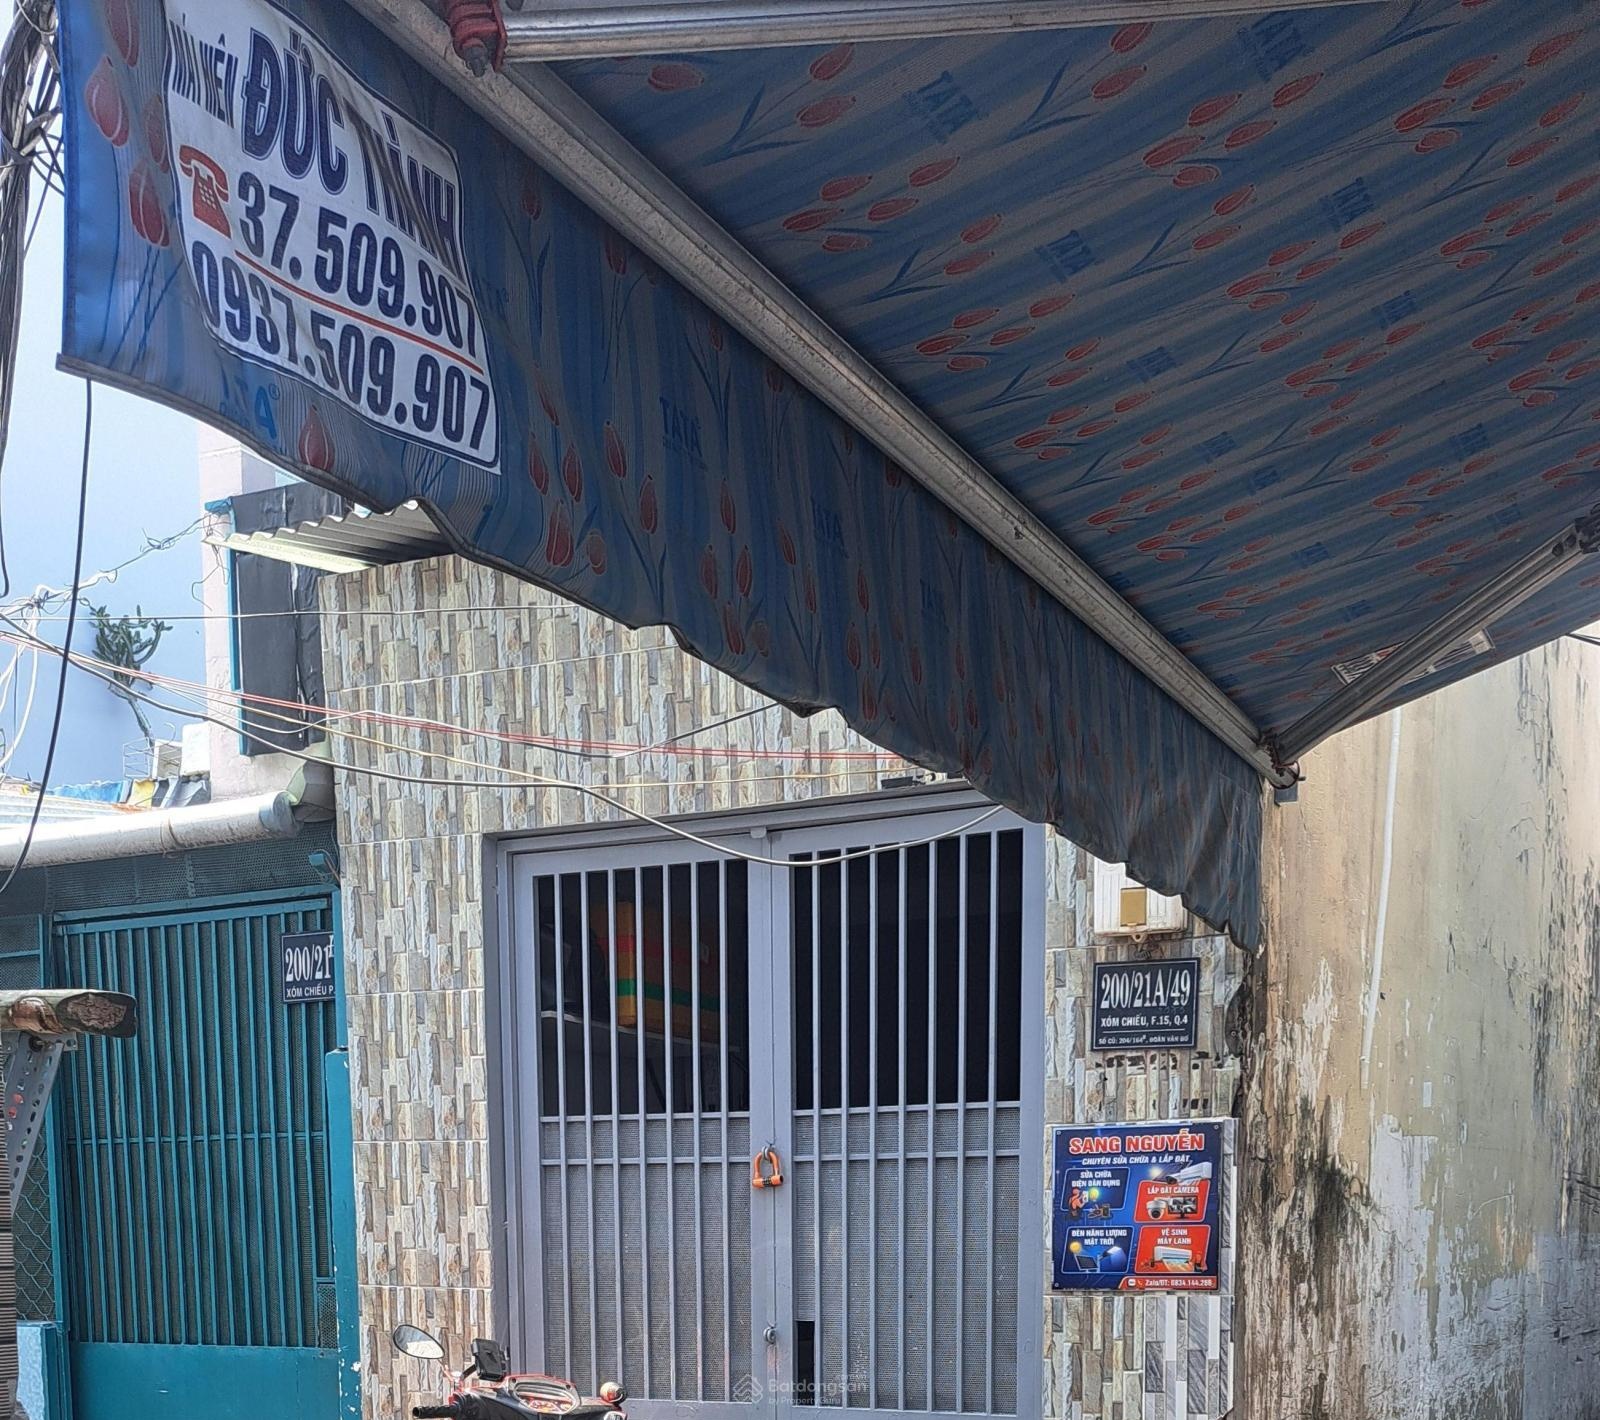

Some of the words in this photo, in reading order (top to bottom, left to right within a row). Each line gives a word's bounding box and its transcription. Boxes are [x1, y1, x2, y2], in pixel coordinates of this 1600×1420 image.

[241, 27, 350, 195] ĐỨC
[237, 171, 478, 358] 37.509.907
[192, 240, 490, 450] 0937.509.907
[286, 986, 303, 998] XÓM
[304, 983, 327, 997] CHIẾU
[1100, 969, 1192, 1010] 200/21A/49
[1101, 1014, 1120, 1027] XÓM
[1121, 1012, 1150, 1028] CHIẾU,
[1151, 1015, 1172, 1027] F.15,
[1174, 1014, 1188, 1025] Q.4
[1069, 1137, 1122, 1154] SANG
[1125, 1128, 1205, 1153] NGUYỄN
[1082, 1156, 1111, 1166] CHUYÊN
[1112, 1155, 1127, 1165] SỬA
[1129, 1154, 1149, 1164] CHỮA
[1158, 1153, 1174, 1163] LẮP
[1080, 1169, 1093, 1179] SỬA
[1094, 1169, 1112, 1178] CHỮA
[1173, 1186, 1199, 1194] CAMERA
[1171, 1228, 1188, 1236] SINH
